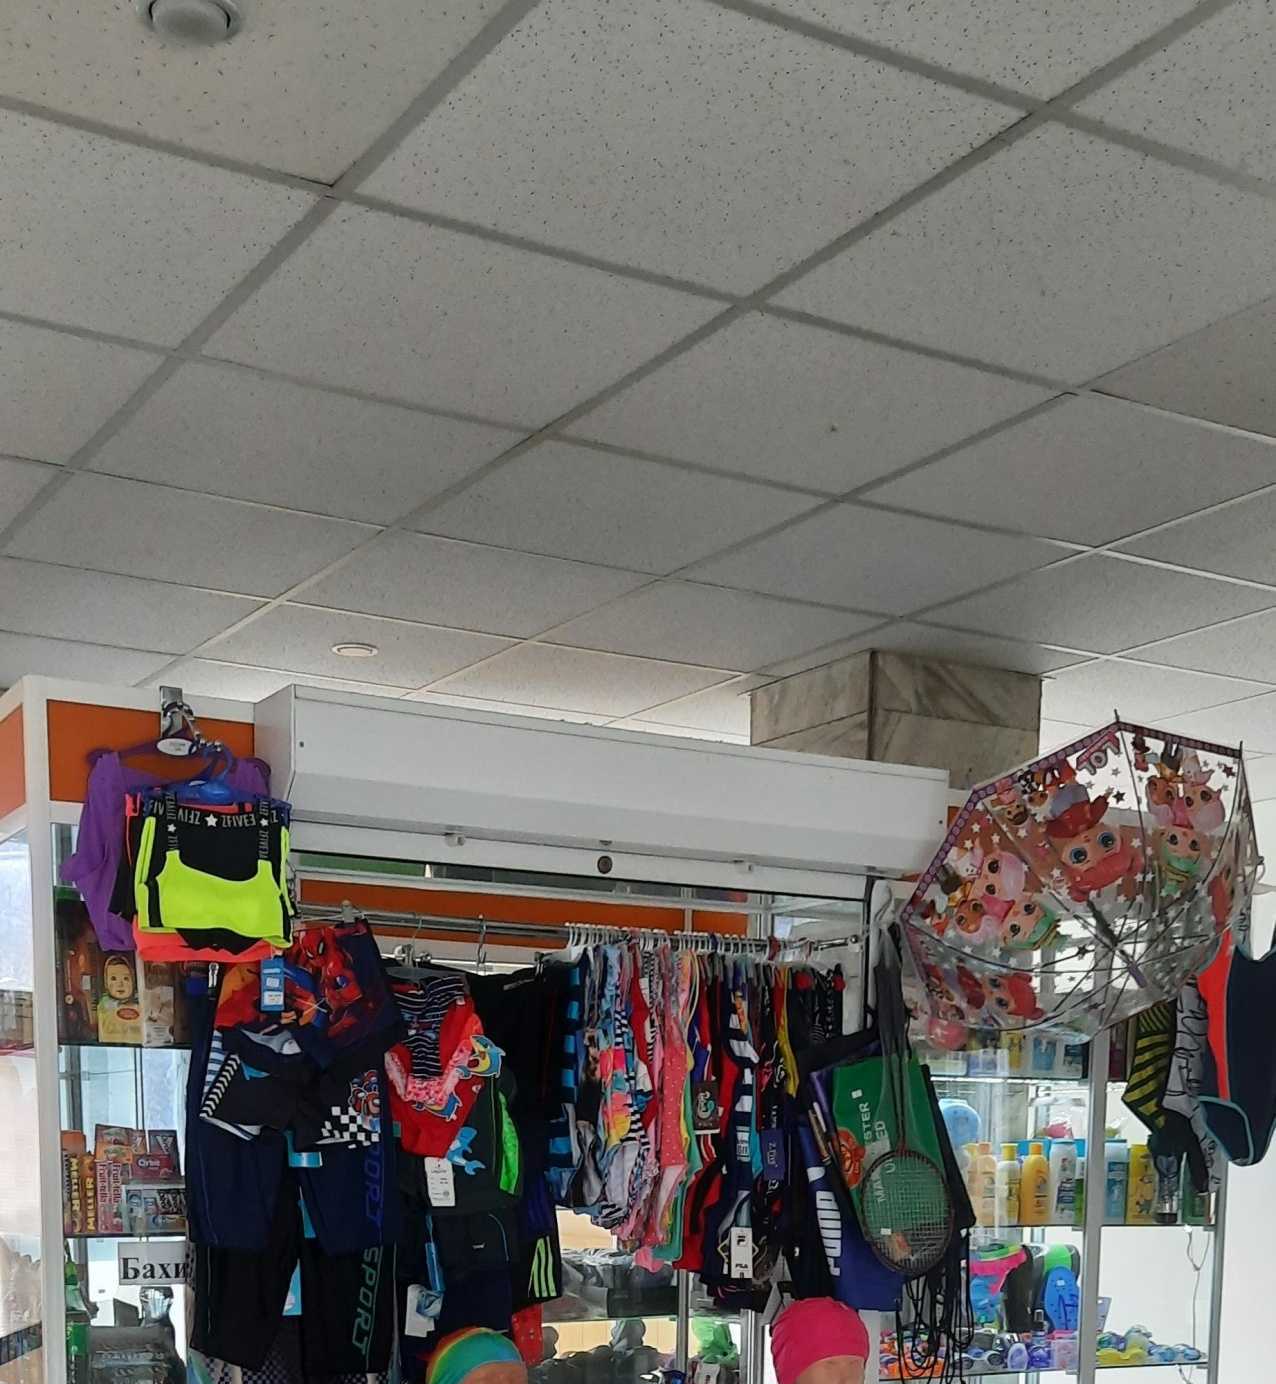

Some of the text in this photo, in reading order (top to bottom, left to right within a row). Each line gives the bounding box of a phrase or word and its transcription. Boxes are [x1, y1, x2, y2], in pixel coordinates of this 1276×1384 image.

[70, 1157, 80, 1212] MELLER
[85, 1177, 96, 1231] MELLER
[351, 1246, 380, 1355] SPORT
